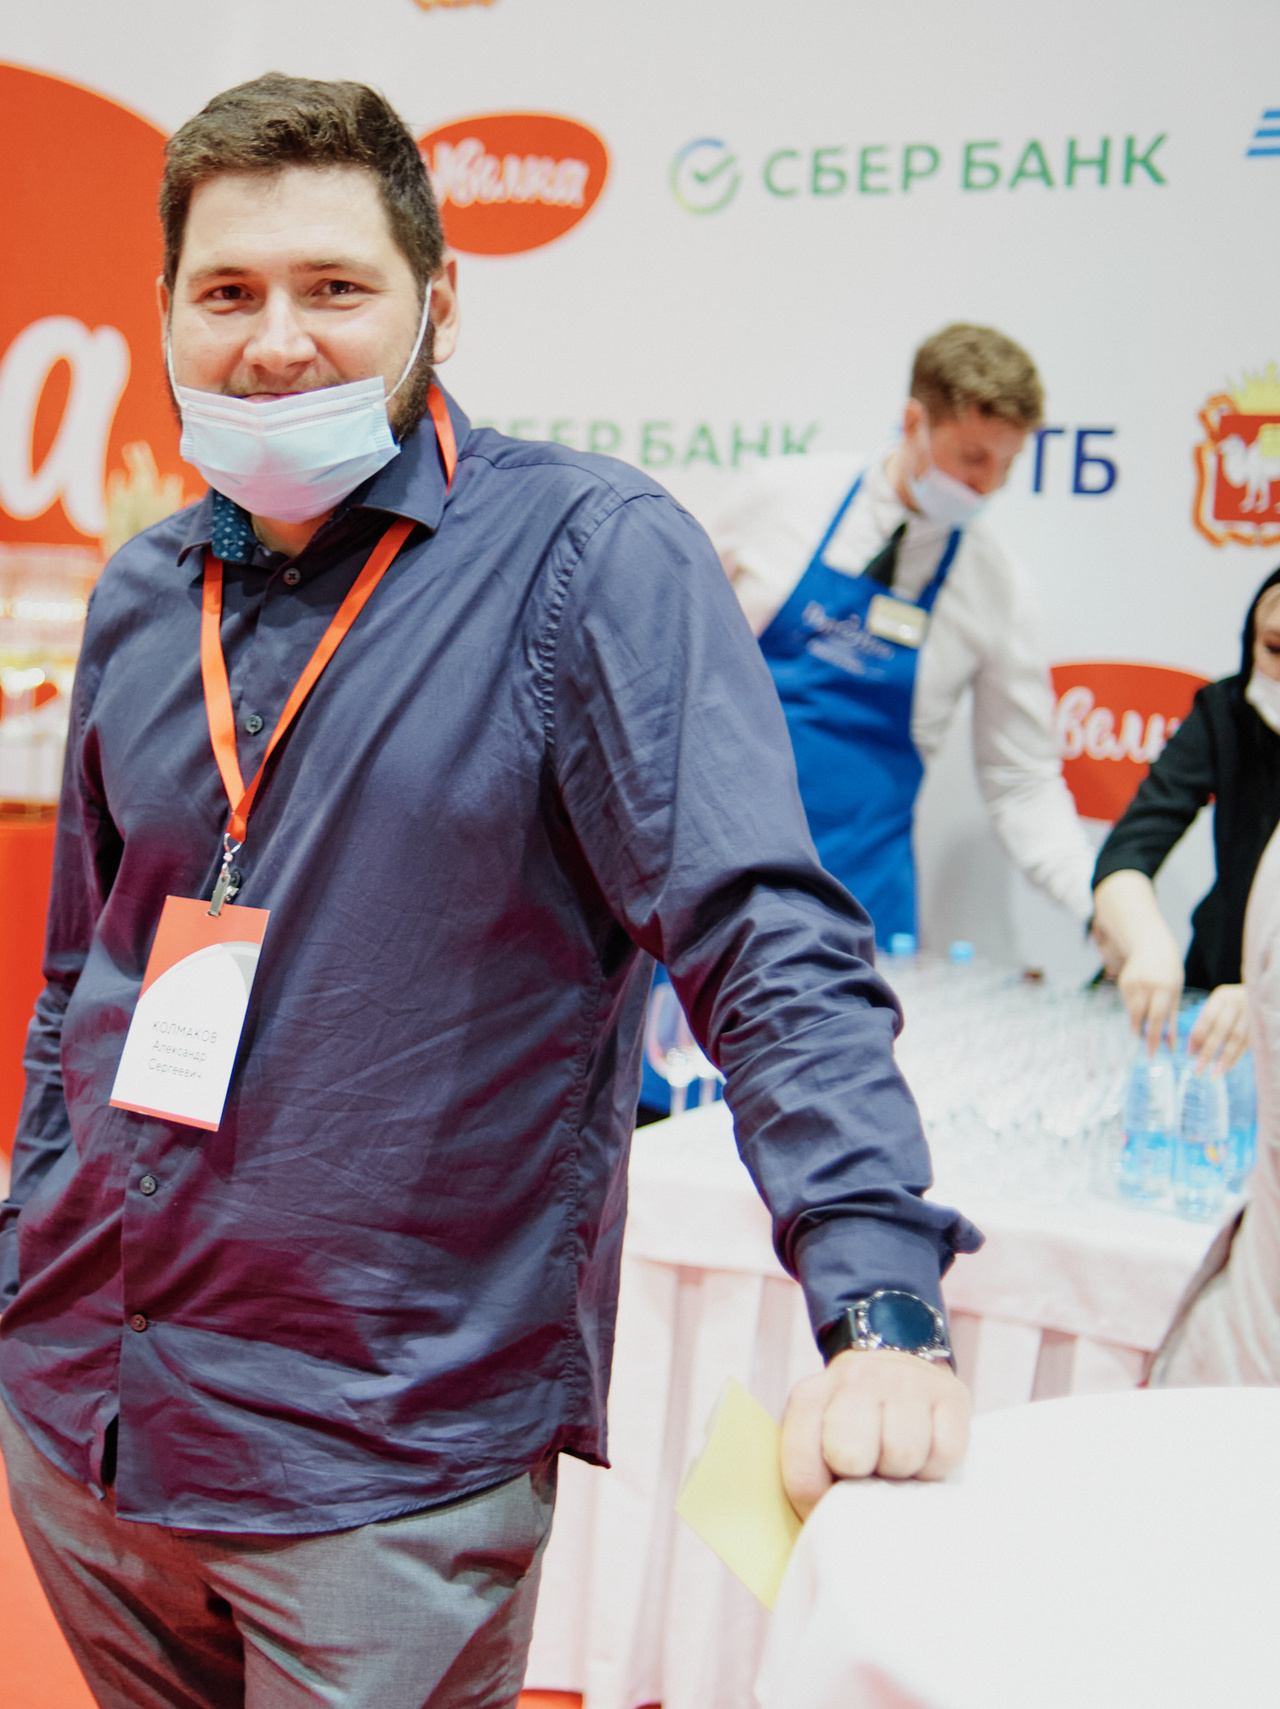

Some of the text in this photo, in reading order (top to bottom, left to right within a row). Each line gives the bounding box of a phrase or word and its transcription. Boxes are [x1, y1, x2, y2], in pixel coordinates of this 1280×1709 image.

[763, 133, 1168, 198] СБЕР БАНК
[1031, 427, 1118, 495] ТБ
[153, 1020, 218, 1044] КОЛМАКОВ
[153, 1039, 207, 1062] Александр
